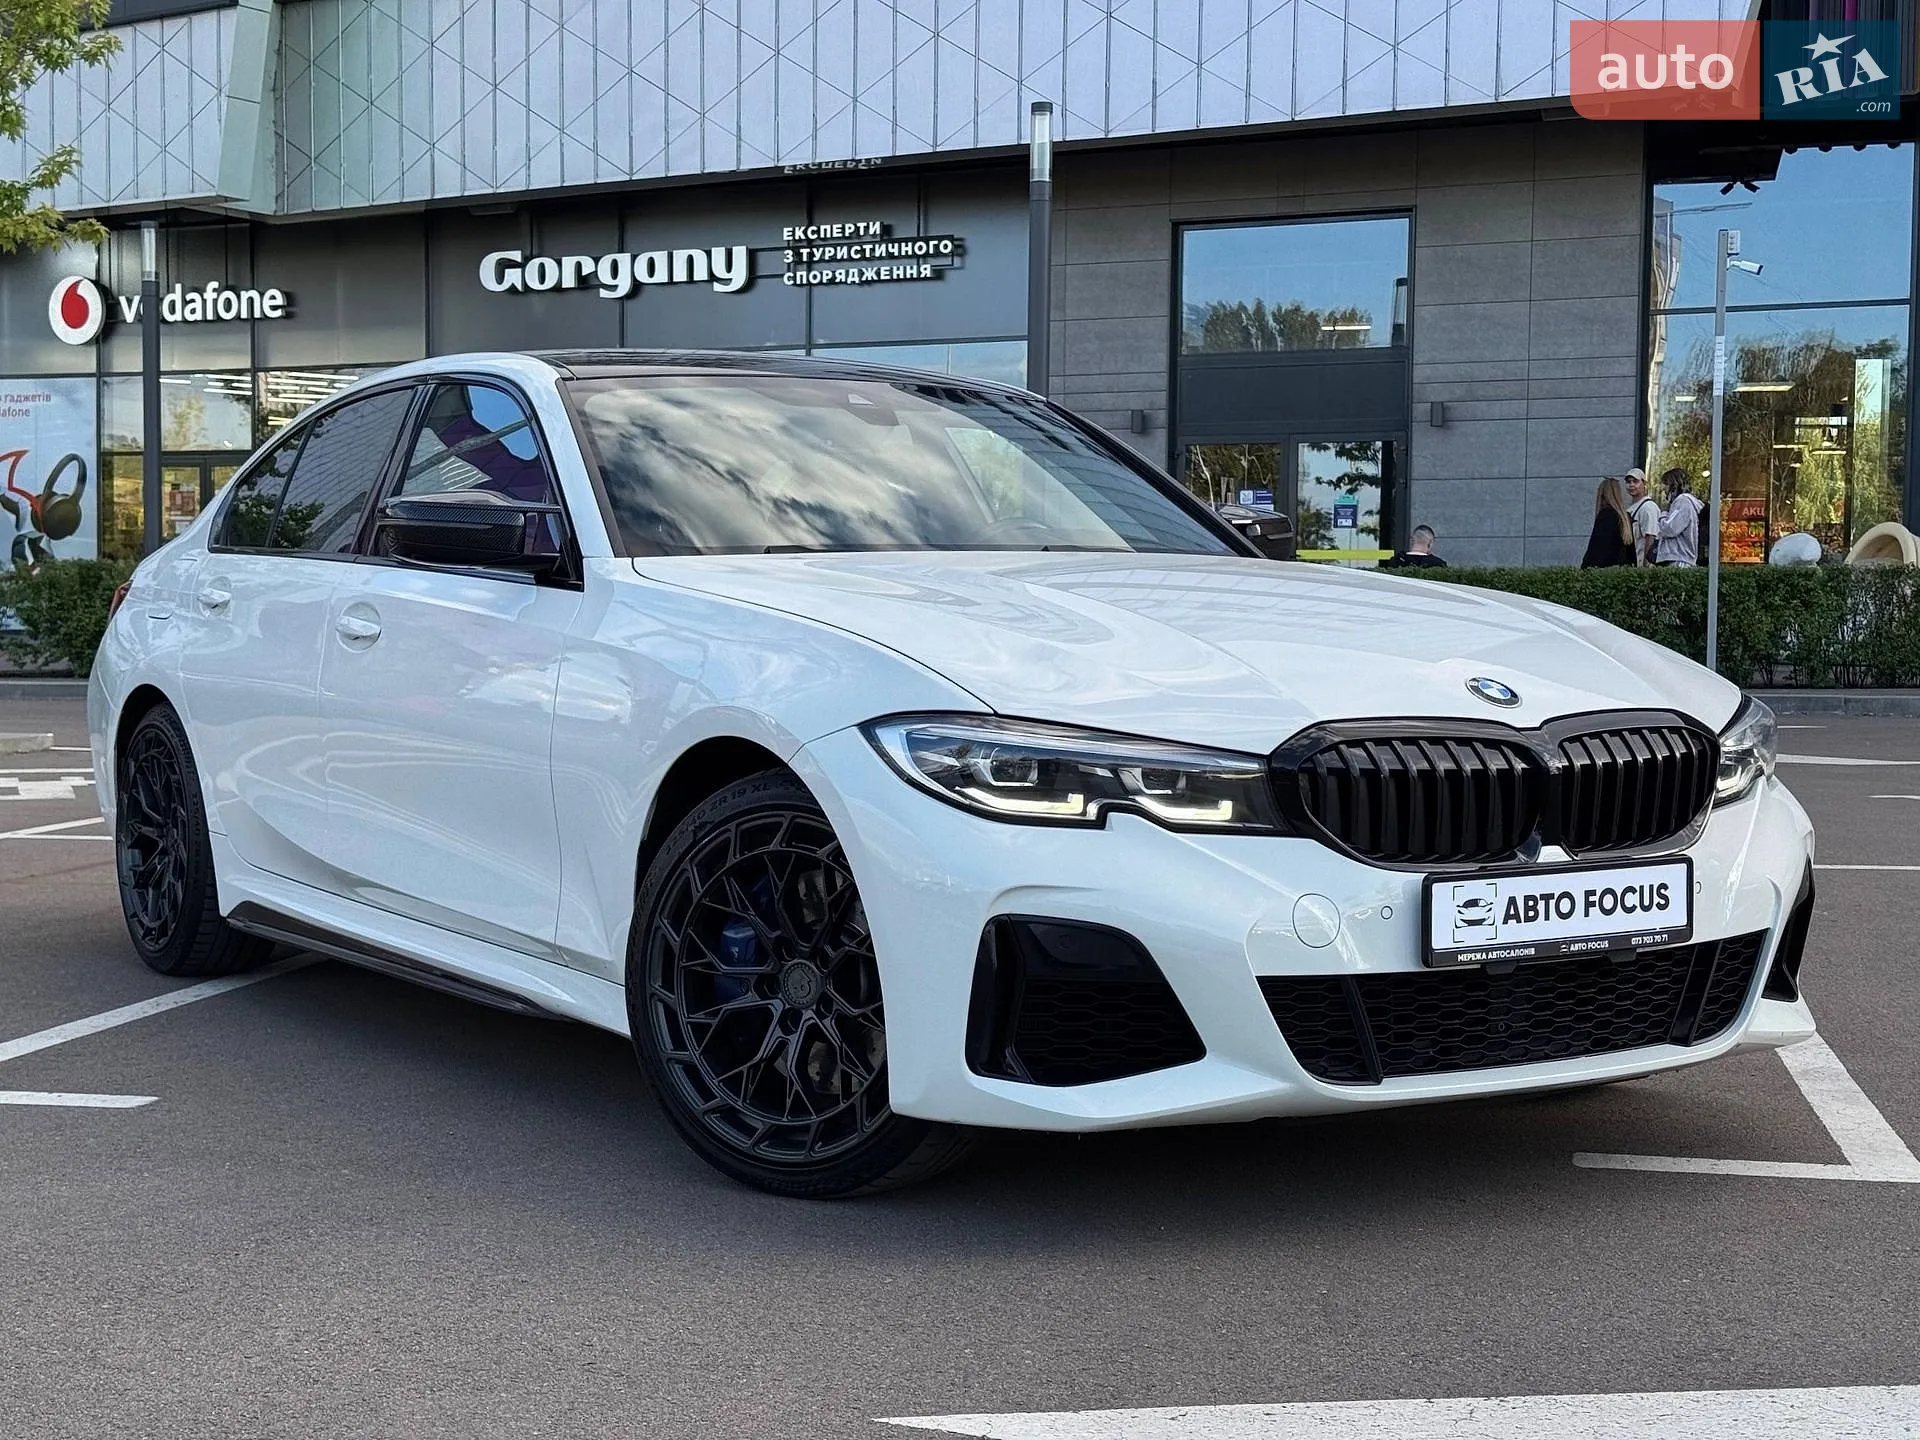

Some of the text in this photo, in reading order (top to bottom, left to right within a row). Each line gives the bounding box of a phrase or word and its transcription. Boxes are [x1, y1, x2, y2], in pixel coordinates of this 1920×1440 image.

[782, 220, 882, 241] ЕКСПЕРТИ
[798, 239, 954, 262] ТУРИСТИЧНОГО
[479, 245, 748, 299] Gorgany
[783, 263, 933, 286] СПОРЯДЖЕННЯ
[119, 281, 286, 323] vdafone
[1502, 882, 1670, 925] АВТО FOCUS
[1588, 940, 1609, 950] FOCUS
